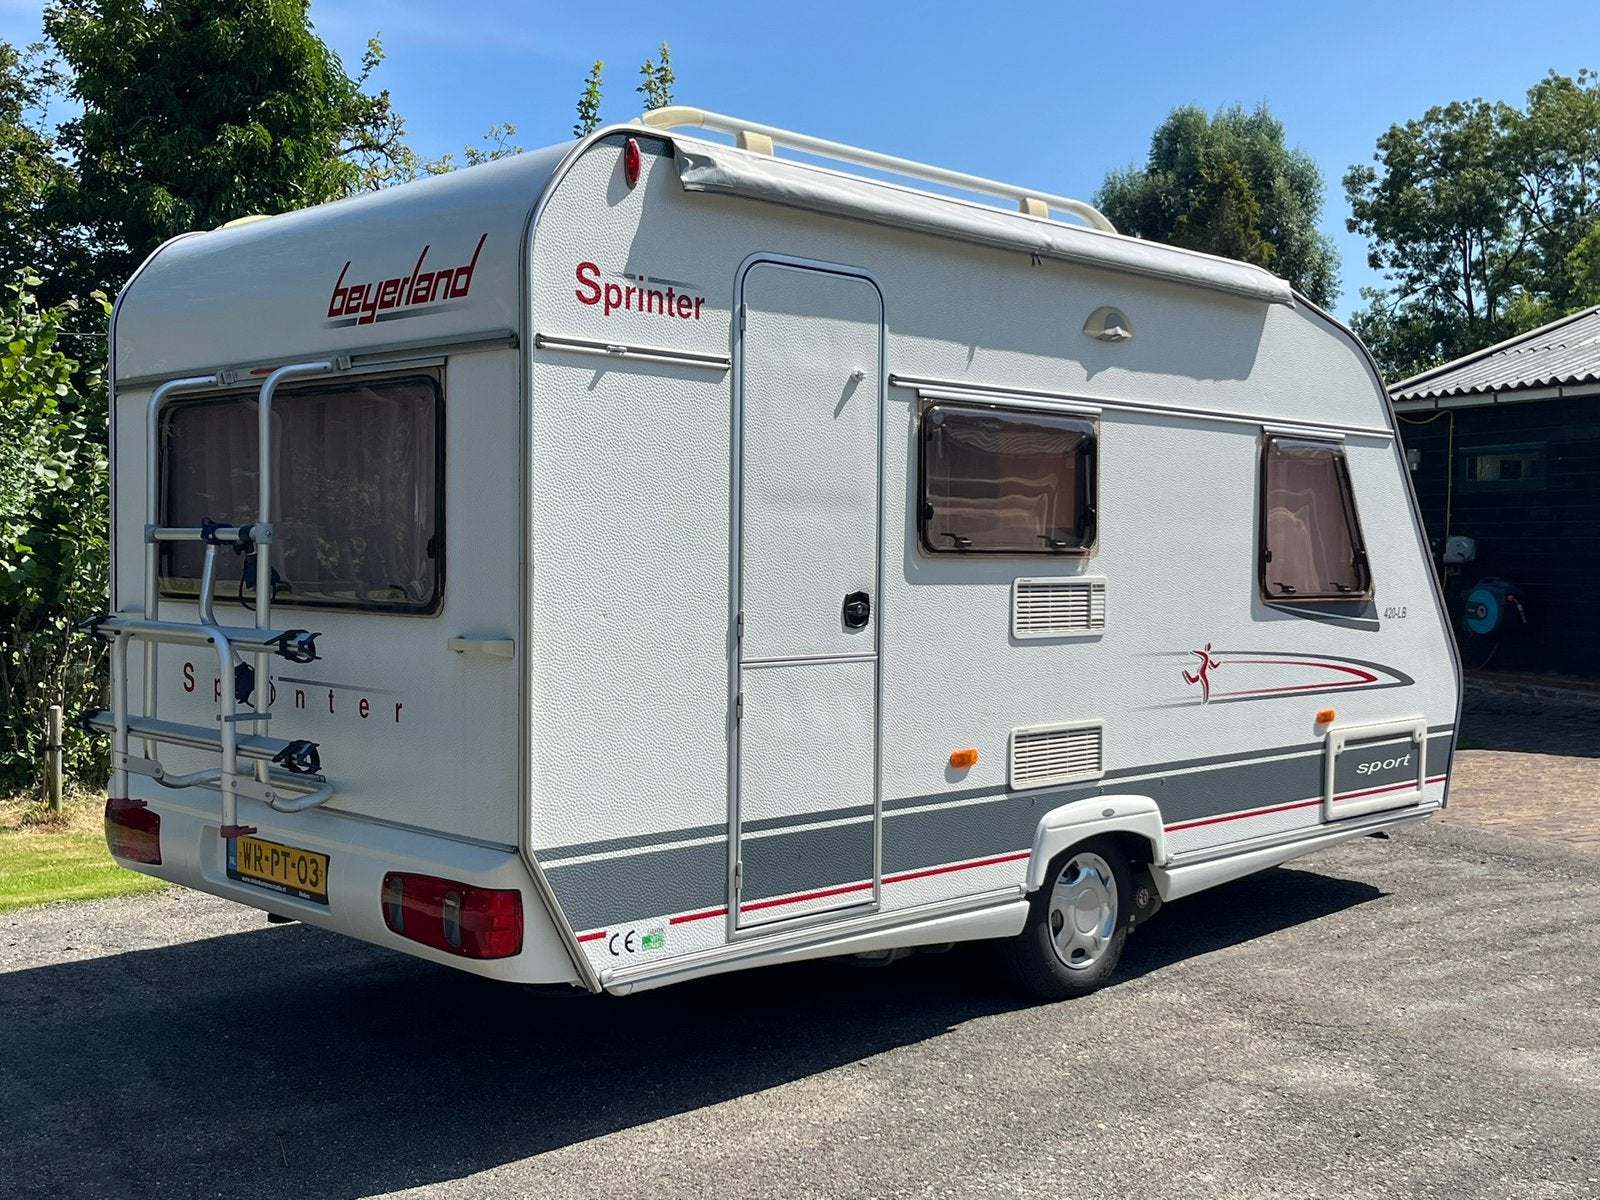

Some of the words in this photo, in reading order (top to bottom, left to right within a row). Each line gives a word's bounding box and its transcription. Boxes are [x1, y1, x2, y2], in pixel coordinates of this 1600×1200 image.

[328, 233, 488, 325] beyerland
[575, 262, 705, 320] Sprinter
[1384, 606, 1407, 619] 420-LB
[183, 662, 403, 723] Spinter
[1356, 753, 1411, 775] sport
[243, 841, 319, 888] WR-PT-03
[609, 930, 635, 956] CE
